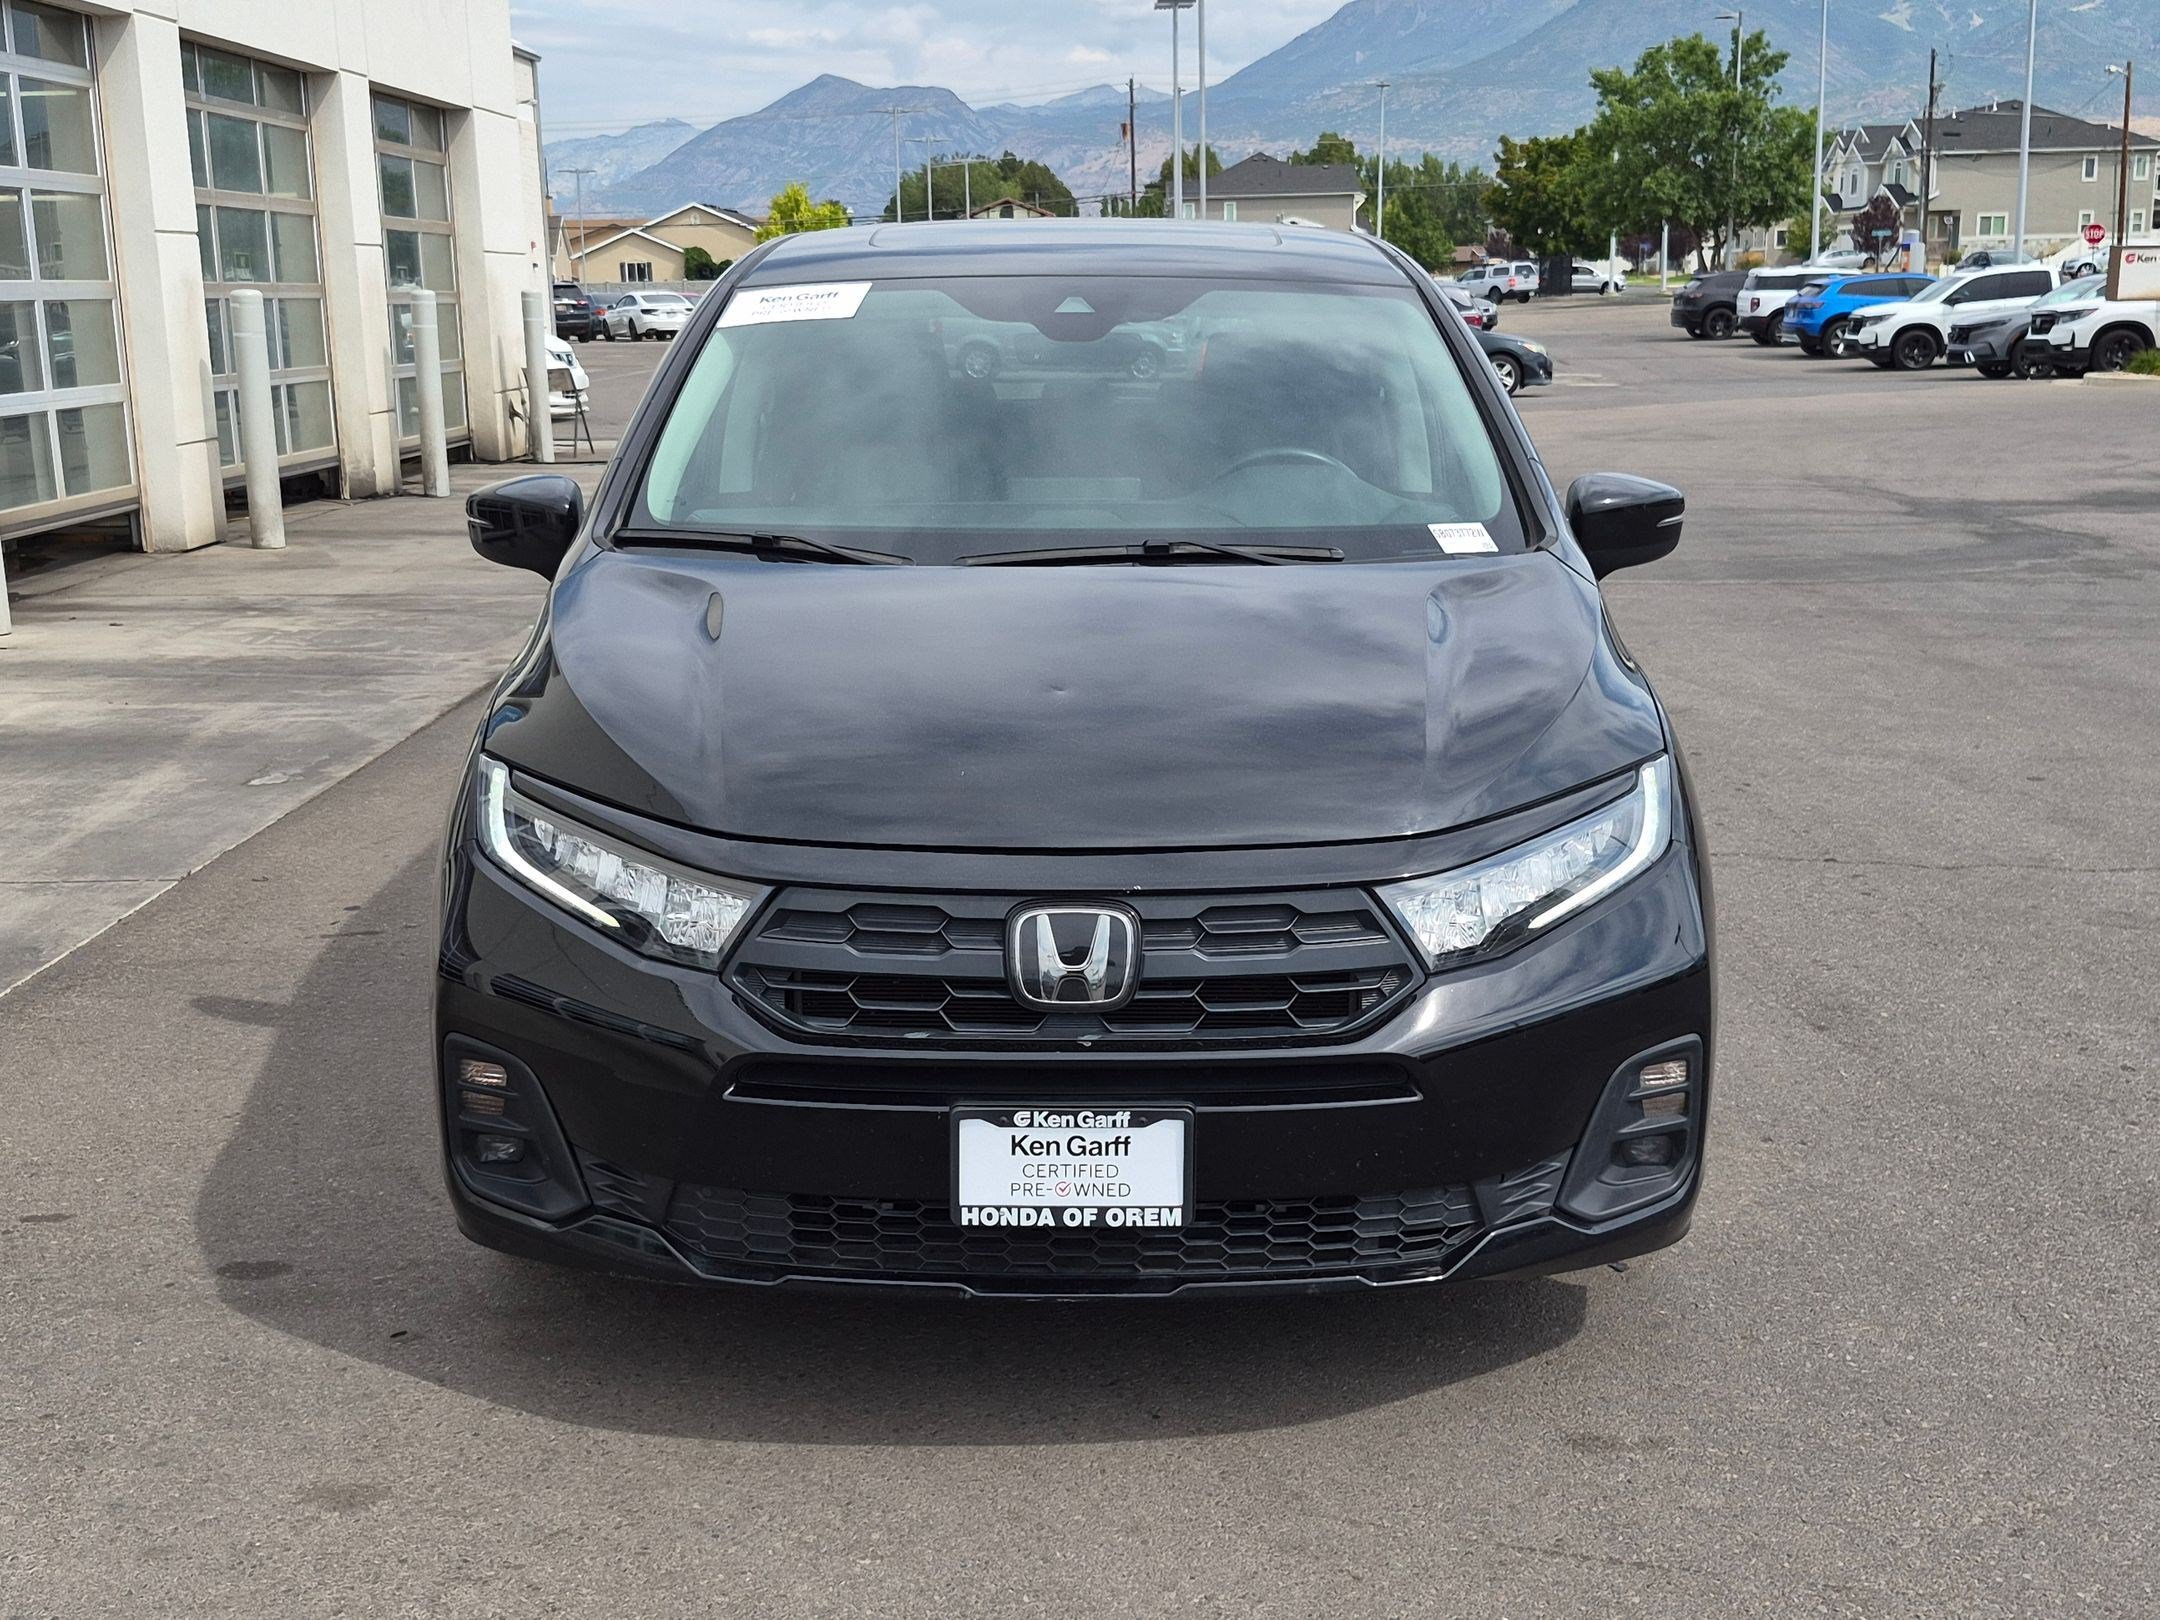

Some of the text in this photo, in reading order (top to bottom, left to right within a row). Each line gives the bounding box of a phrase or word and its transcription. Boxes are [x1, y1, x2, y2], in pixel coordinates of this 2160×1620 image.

[2085, 228, 2105, 240] STOP
[2137, 253, 2157, 263] Ken
[759, 291, 840, 304] Ken Garff
[1033, 1111, 1074, 1128] Ken
[1077, 1111, 1131, 1128] Garff
[1011, 1134, 1131, 1157] Ken Garff
[1022, 1163, 1119, 1179] CERTIFIED
[961, 1207, 1182, 1227] HONDA OF OREM
